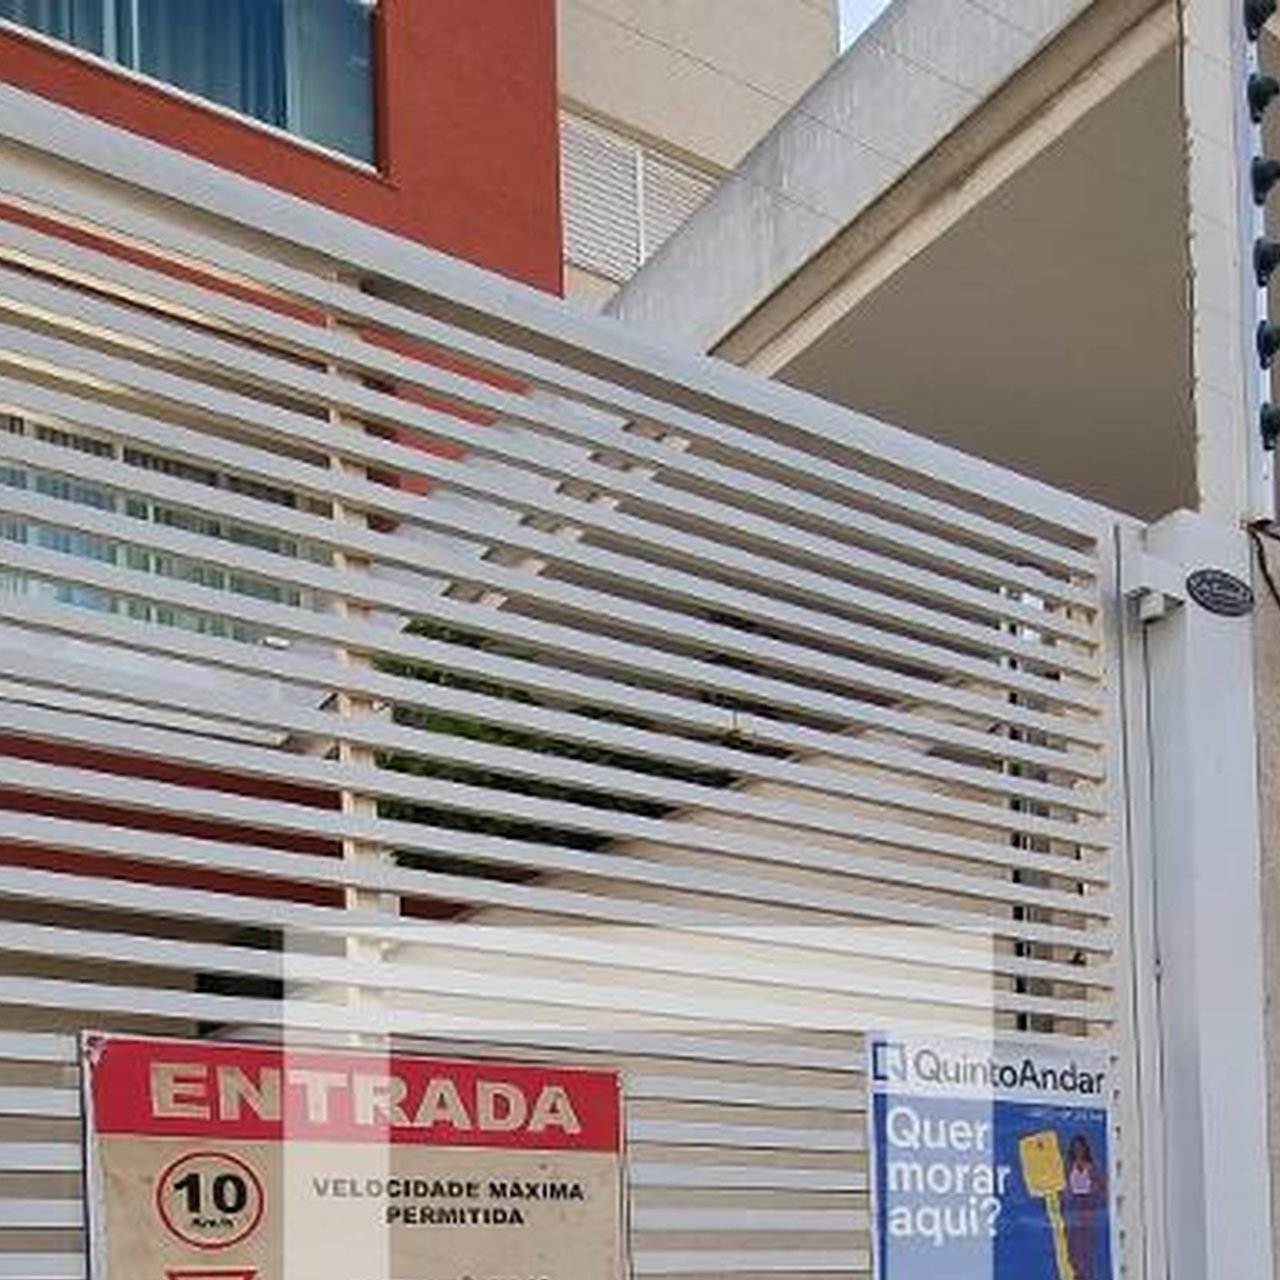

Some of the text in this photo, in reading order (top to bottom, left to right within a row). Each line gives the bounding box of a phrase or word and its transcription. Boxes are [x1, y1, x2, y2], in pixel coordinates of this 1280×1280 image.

[914, 1047, 1106, 1095] QuintoAndar
[149, 1062, 582, 1135] ENTRADA
[885, 1105, 990, 1152] Quer
[173, 1172, 248, 1214] 10
[312, 1177, 481, 1199] VELOCIDADE
[888, 1159, 1011, 1195] morar
[384, 1205, 525, 1226] PERMITIDA
[888, 1196, 1002, 1248] aqui?
